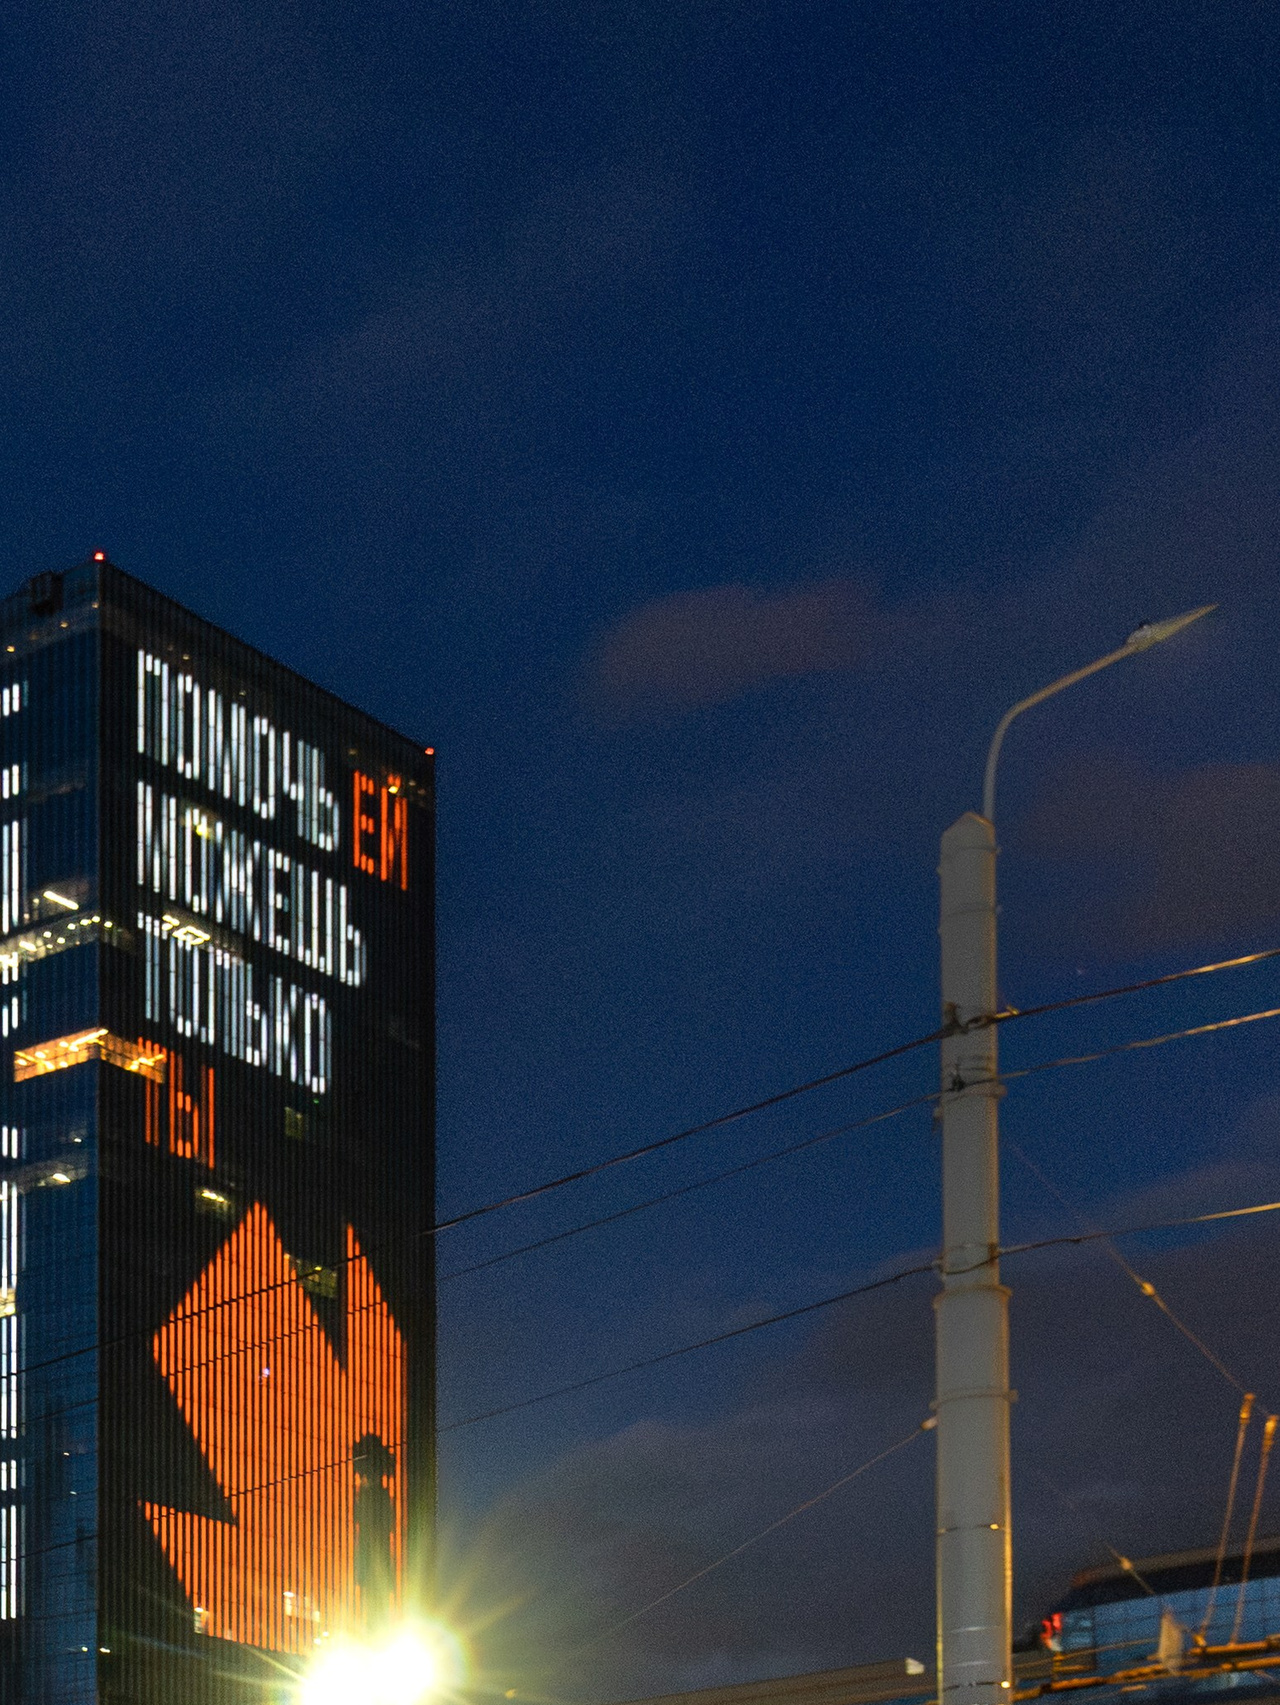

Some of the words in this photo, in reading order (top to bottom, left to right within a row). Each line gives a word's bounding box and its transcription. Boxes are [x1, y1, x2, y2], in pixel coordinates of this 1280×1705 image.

[137, 648, 340, 852] ПОМОЧЬ
[353, 769, 409, 891] ЕЙ
[137, 780, 368, 988] МОЖЕШЬ
[137, 911, 333, 1095] ТОЛЬКО
[137, 1036, 216, 1170] ТЫ
